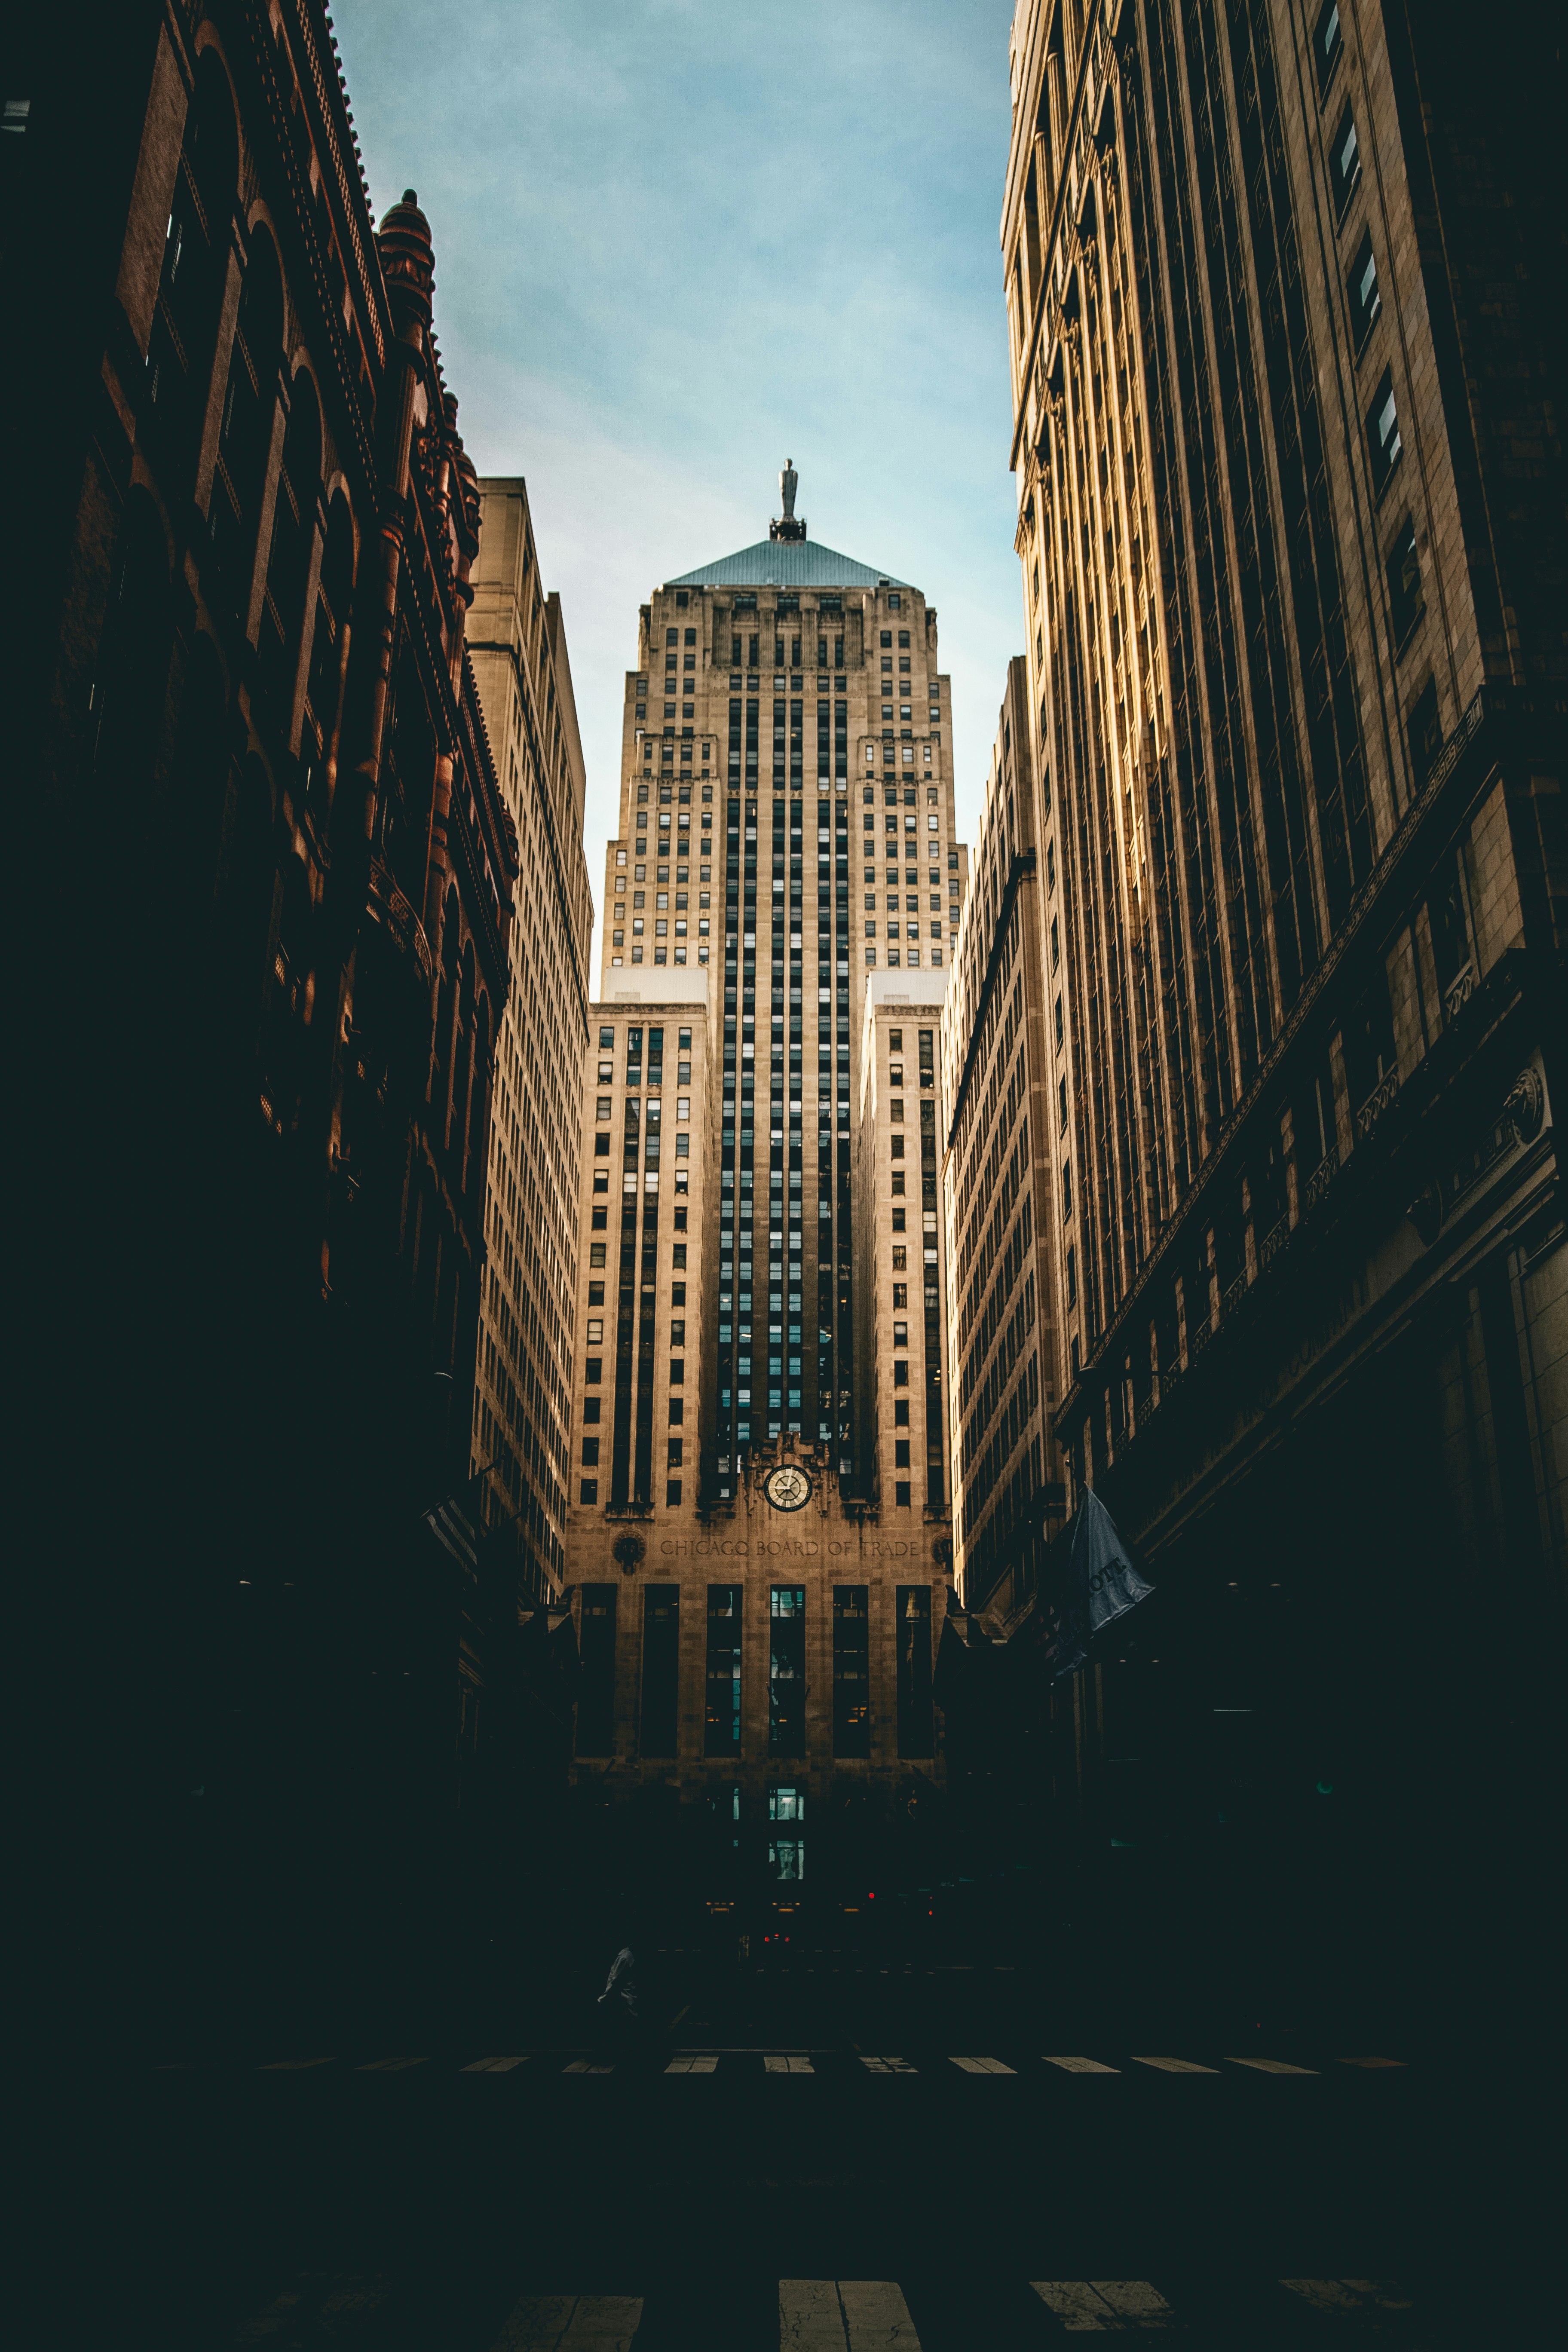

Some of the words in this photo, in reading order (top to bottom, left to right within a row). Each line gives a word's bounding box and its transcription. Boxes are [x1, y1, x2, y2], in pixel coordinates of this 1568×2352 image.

[660, 1540, 748, 1556] CHICAGO
[757, 1540, 818, 1556] BOARD
[827, 1541, 852, 1556] OF
[862, 1541, 919, 1556] TRADE
[1089, 1556, 1127, 1598] OTT.
